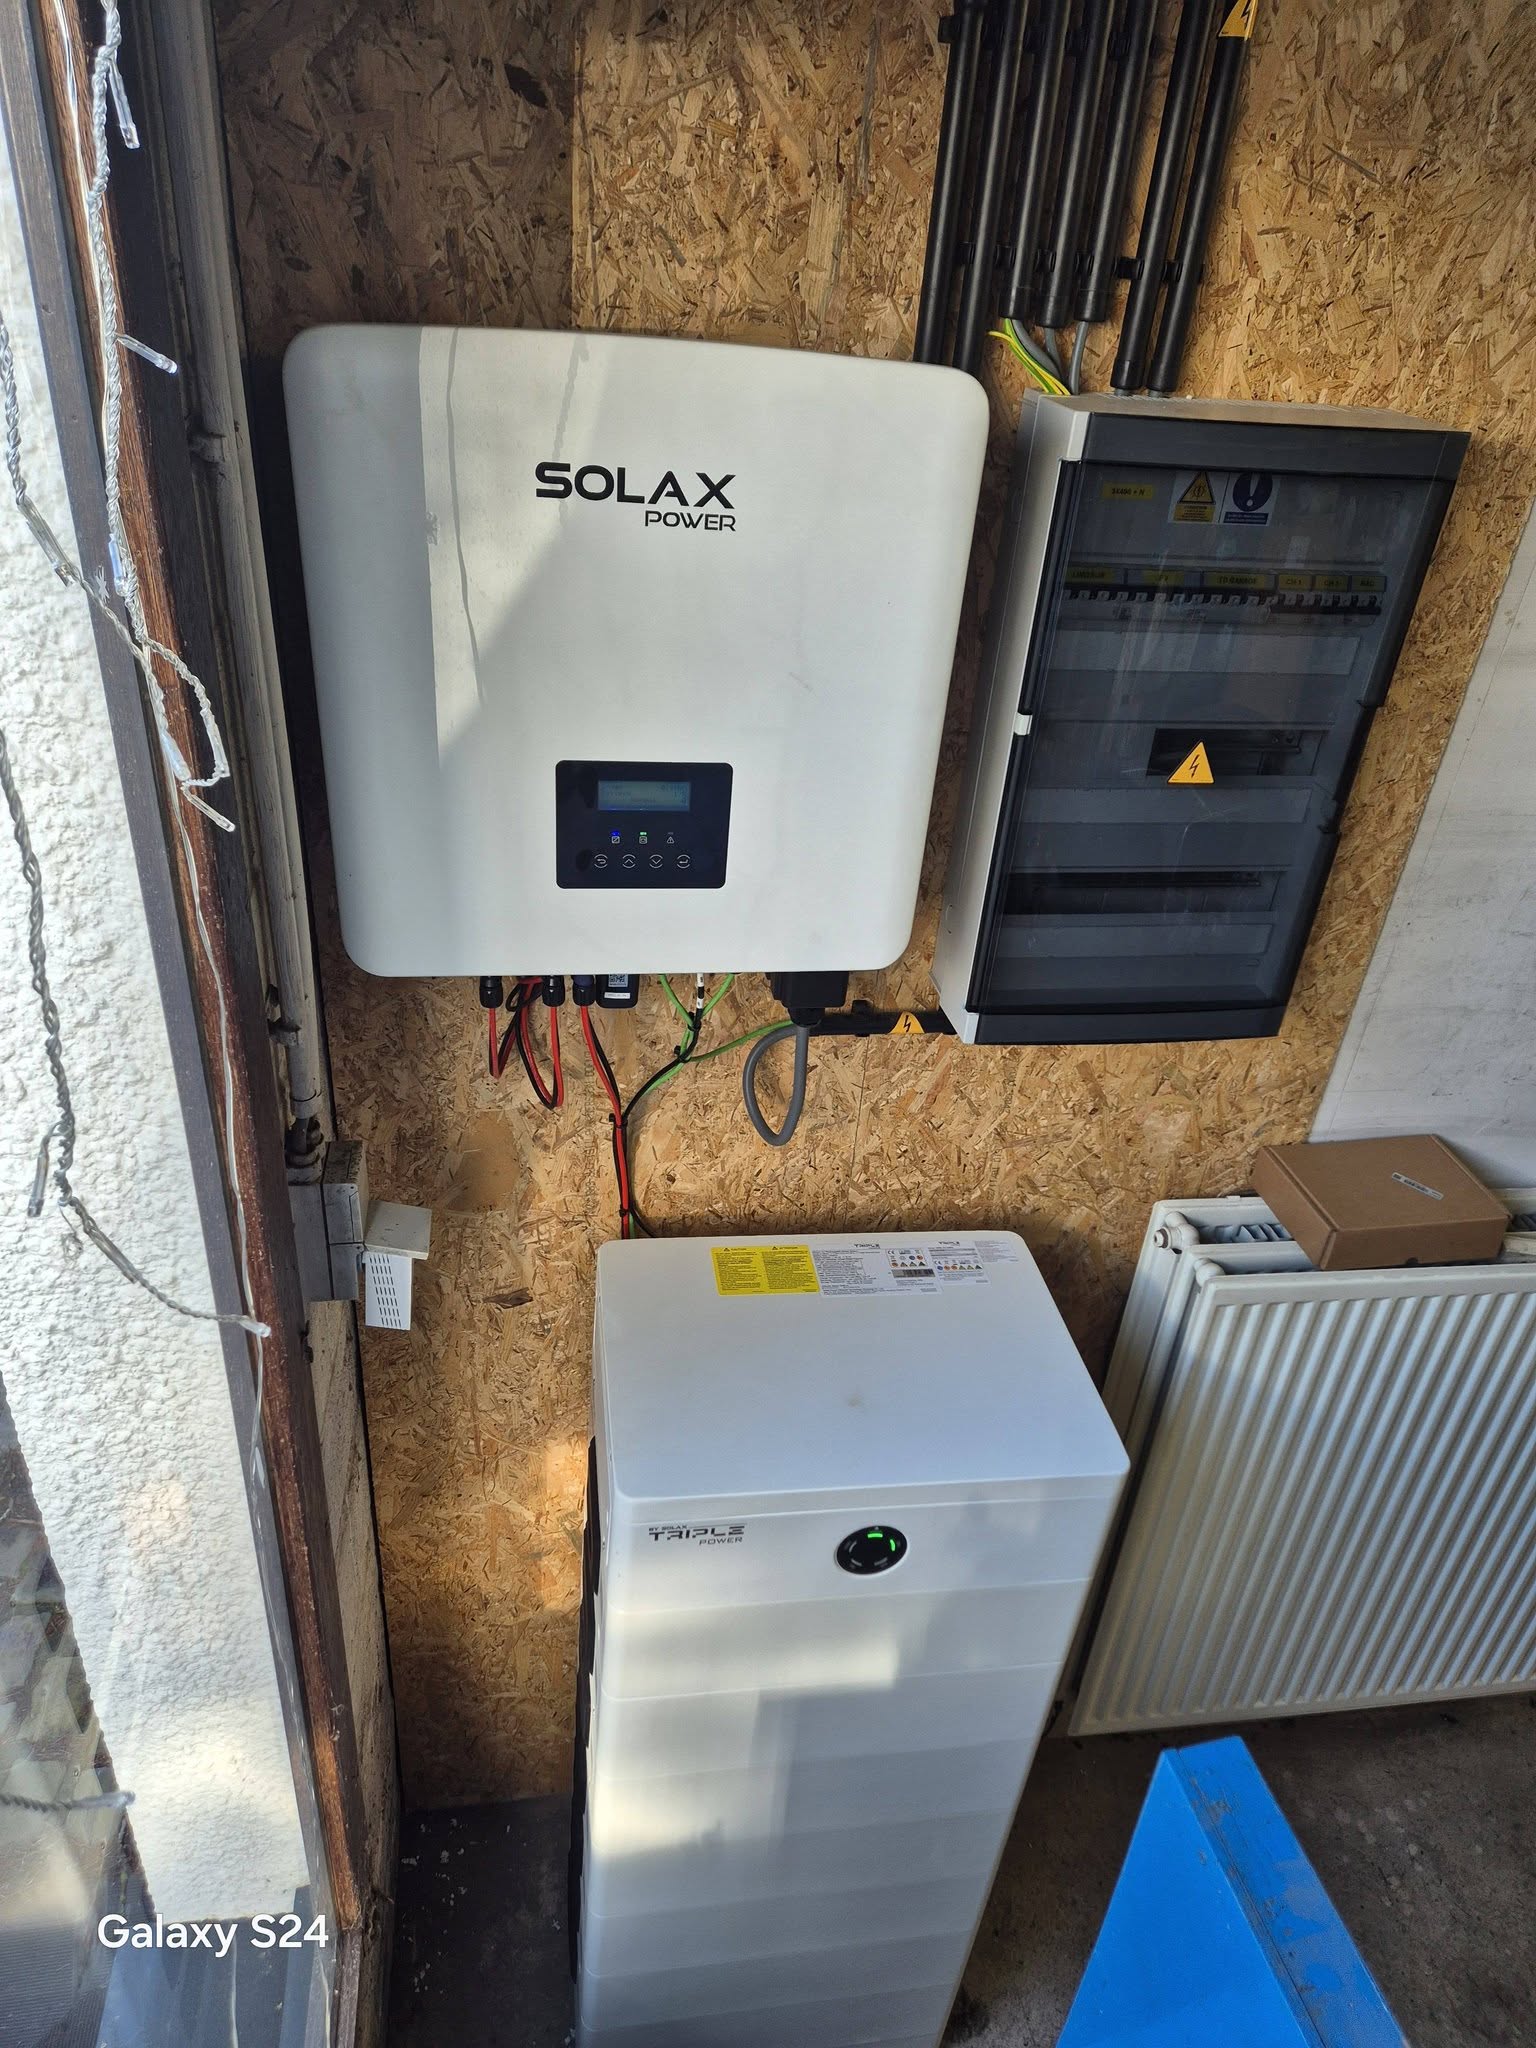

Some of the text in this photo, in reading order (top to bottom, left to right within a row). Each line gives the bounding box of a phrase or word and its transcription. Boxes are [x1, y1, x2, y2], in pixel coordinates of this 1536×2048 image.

[534, 461, 737, 510] SOLAX
[644, 510, 737, 532] POWER
[648, 1526, 745, 1541] TRIPLE
[698, 1537, 743, 1546] POWER
